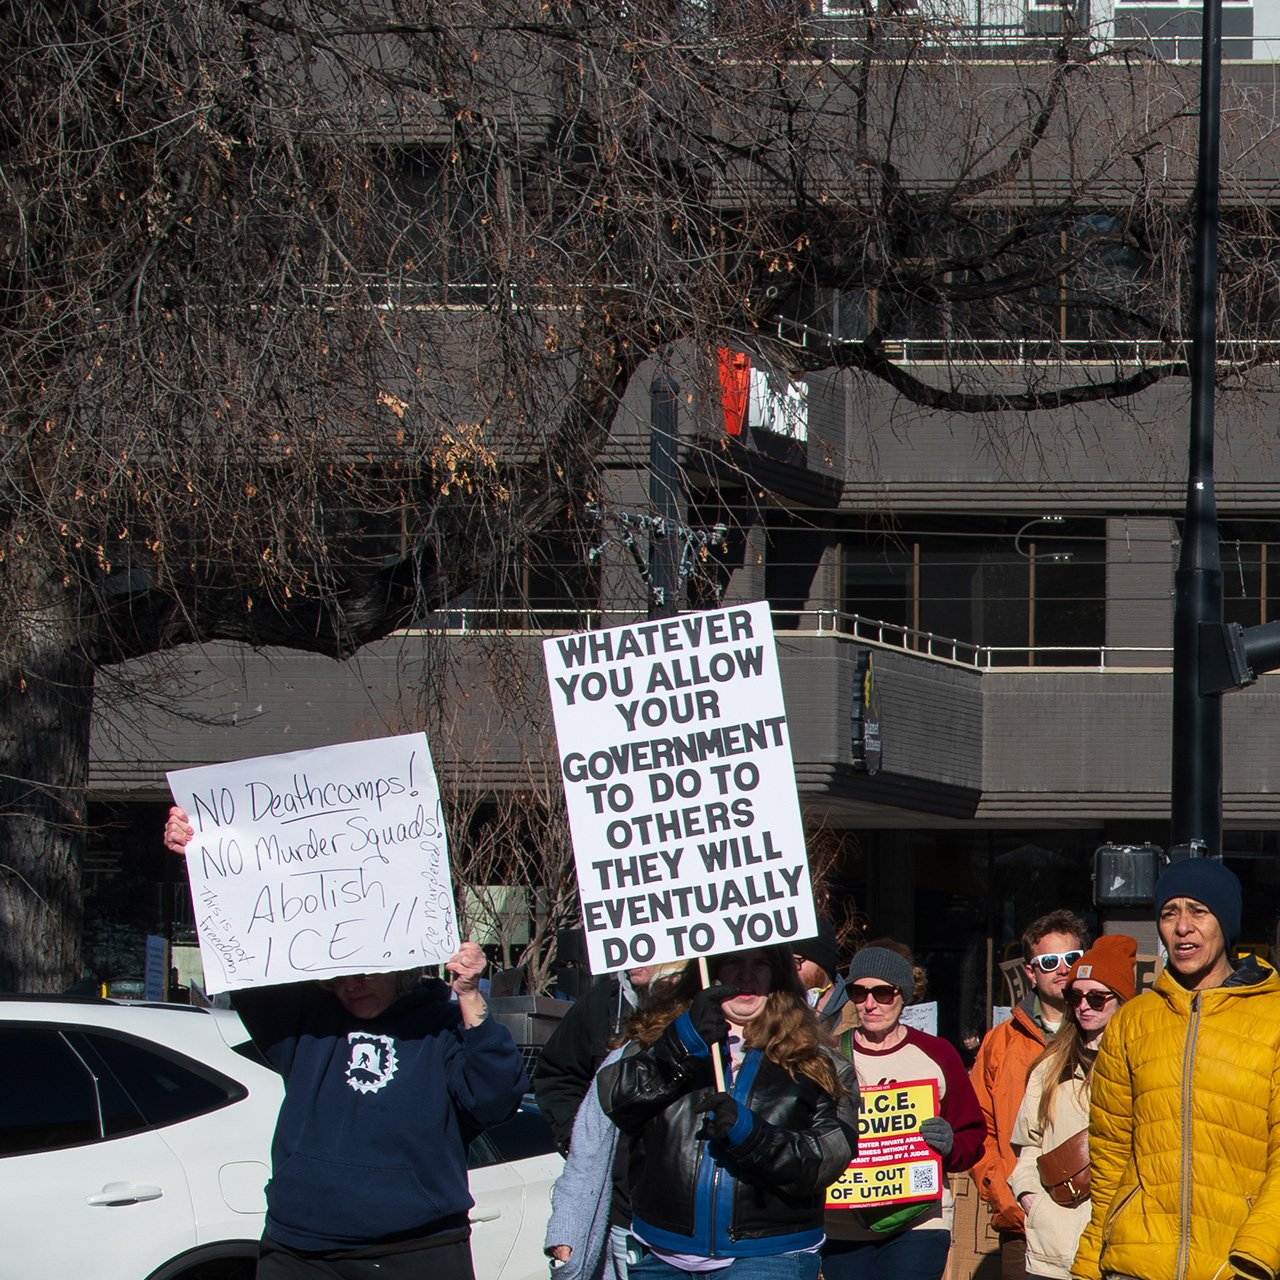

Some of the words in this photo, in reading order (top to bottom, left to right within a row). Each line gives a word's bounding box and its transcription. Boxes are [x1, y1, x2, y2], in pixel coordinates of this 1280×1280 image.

[557, 610, 753, 668] WHATEVER
[555, 666, 633, 705] YOU
[646, 645, 763, 693] ALLOW
[615, 689, 720, 732] YOUR
[563, 715, 786, 782] GOVERNMENT
[192, 787, 235, 832] NO
[586, 783, 633, 814] TO
[649, 769, 701, 803] DO
[710, 762, 759, 796] TO
[606, 798, 754, 849] OTHERS
[201, 837, 243, 879] NO
[255, 828, 346, 871] Murder
[592, 848, 684, 890] THEY
[697, 831, 782, 873] WILL
[247, 867, 385, 934] Abolish
[584, 865, 803, 932] EVENTUALLY
[602, 933, 655, 968] DO
[667, 923, 715, 957] TO
[723, 906, 798, 946] YOU
[880, 1138, 904, 1147] PRIVATE
[882, 1145, 908, 1154] WITHOUT
[894, 1152, 902, 1160] BY
[909, 1150, 930, 1158] JUDGE
[830, 1188, 853, 1200] OF
[860, 1183, 903, 1199] UTAH
[875, 1167, 906, 1181] OUT
